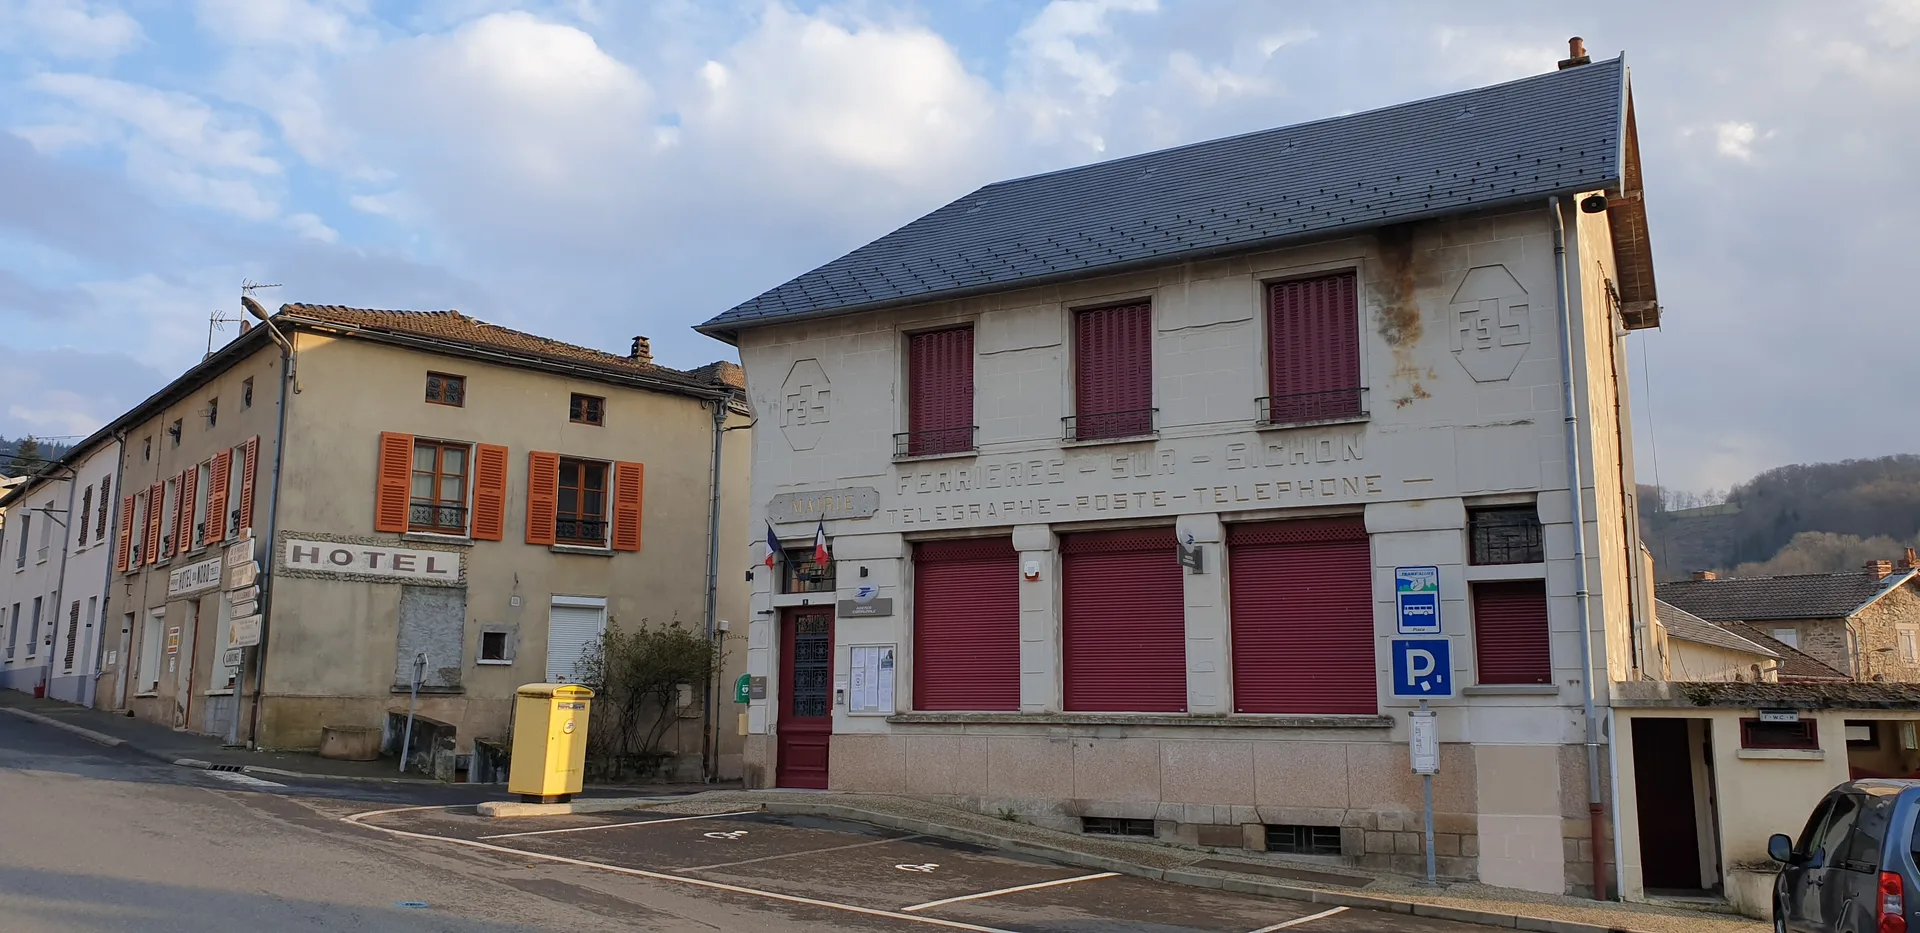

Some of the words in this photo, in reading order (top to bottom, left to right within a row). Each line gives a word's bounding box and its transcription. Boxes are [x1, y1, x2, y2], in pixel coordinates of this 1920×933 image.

[896, 458, 1065, 496] FERRIERES
[1111, 449, 1176, 480] SUR
[1226, 434, 1363, 470] SICHON
[791, 494, 855, 514] MAIRIE
[292, 545, 448, 573] HOTEL
[178, 568, 192, 591] HOTEL
[196, 563, 210, 585] NORD
[1406, 649, 1435, 685] P
